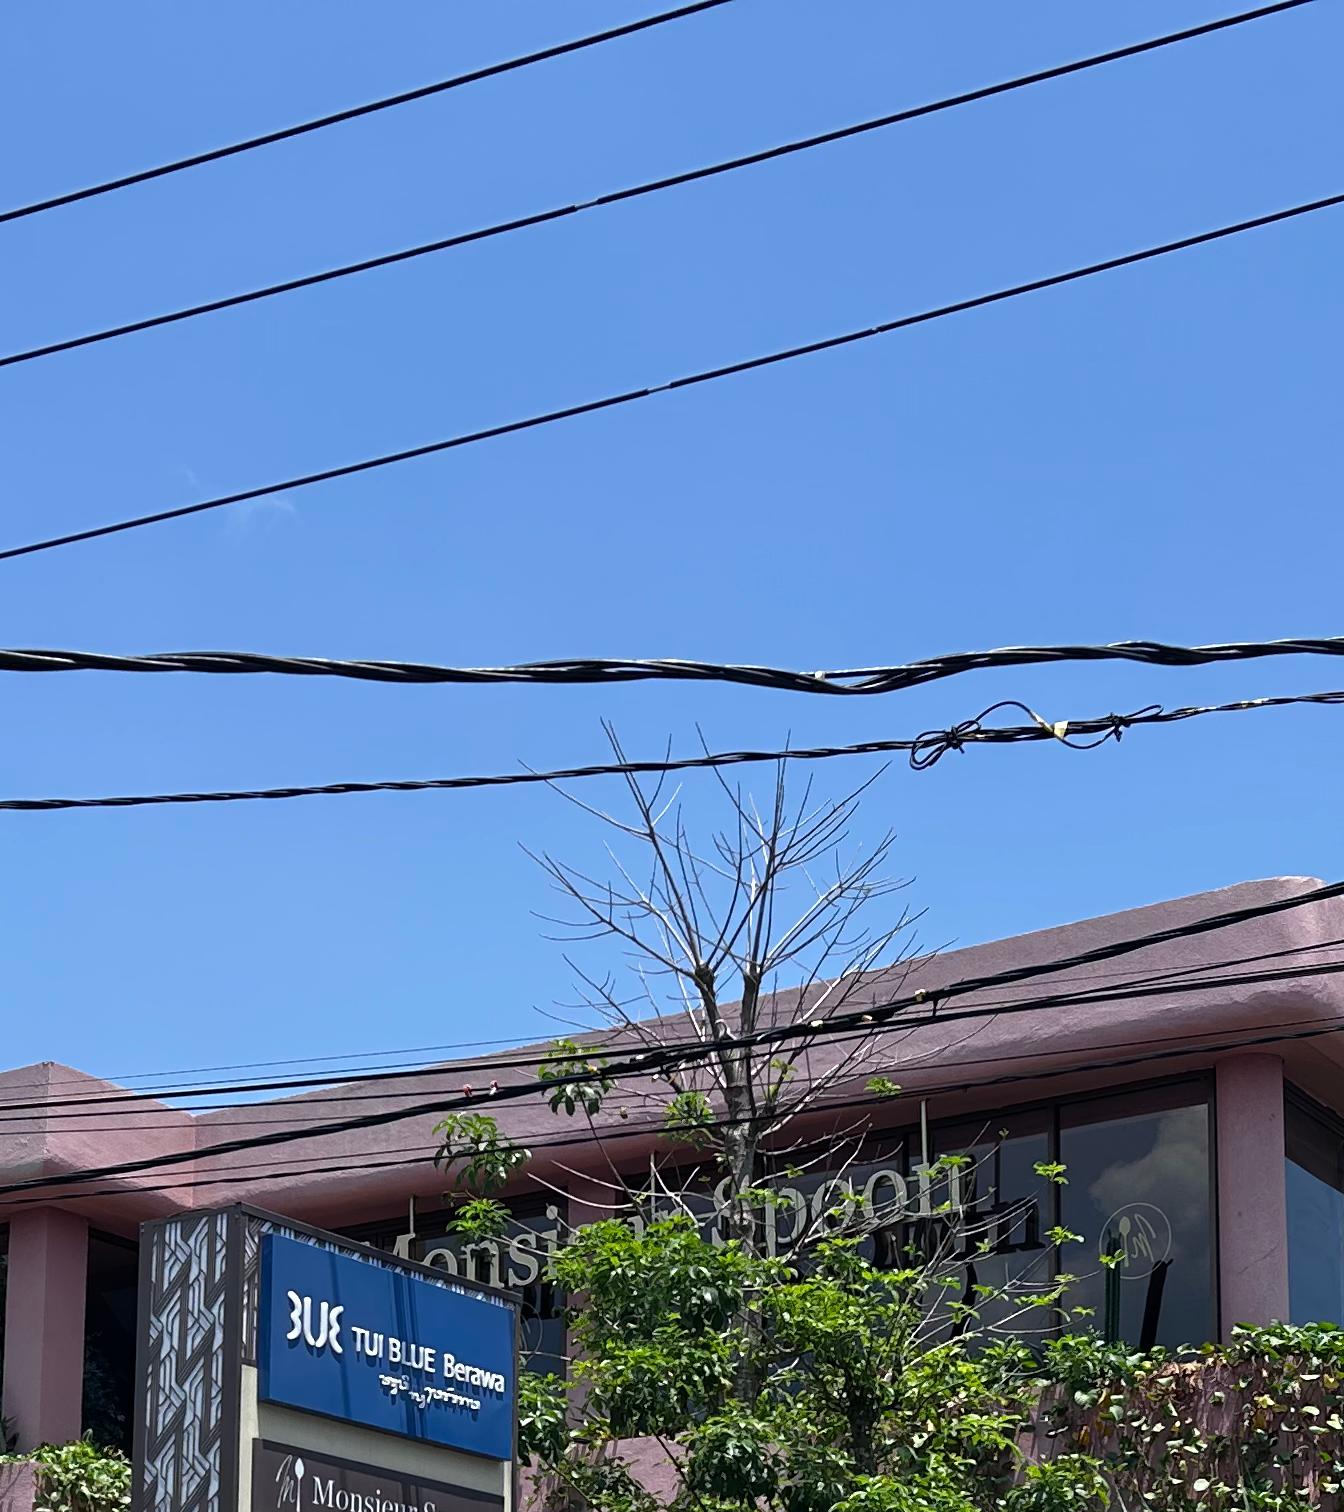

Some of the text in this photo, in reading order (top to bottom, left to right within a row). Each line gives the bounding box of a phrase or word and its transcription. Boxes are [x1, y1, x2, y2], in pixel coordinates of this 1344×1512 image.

[351, 1326, 384, 1359] TUI
[388, 1336, 436, 1373] BLUE
[443, 1353, 505, 1393] Berawa
